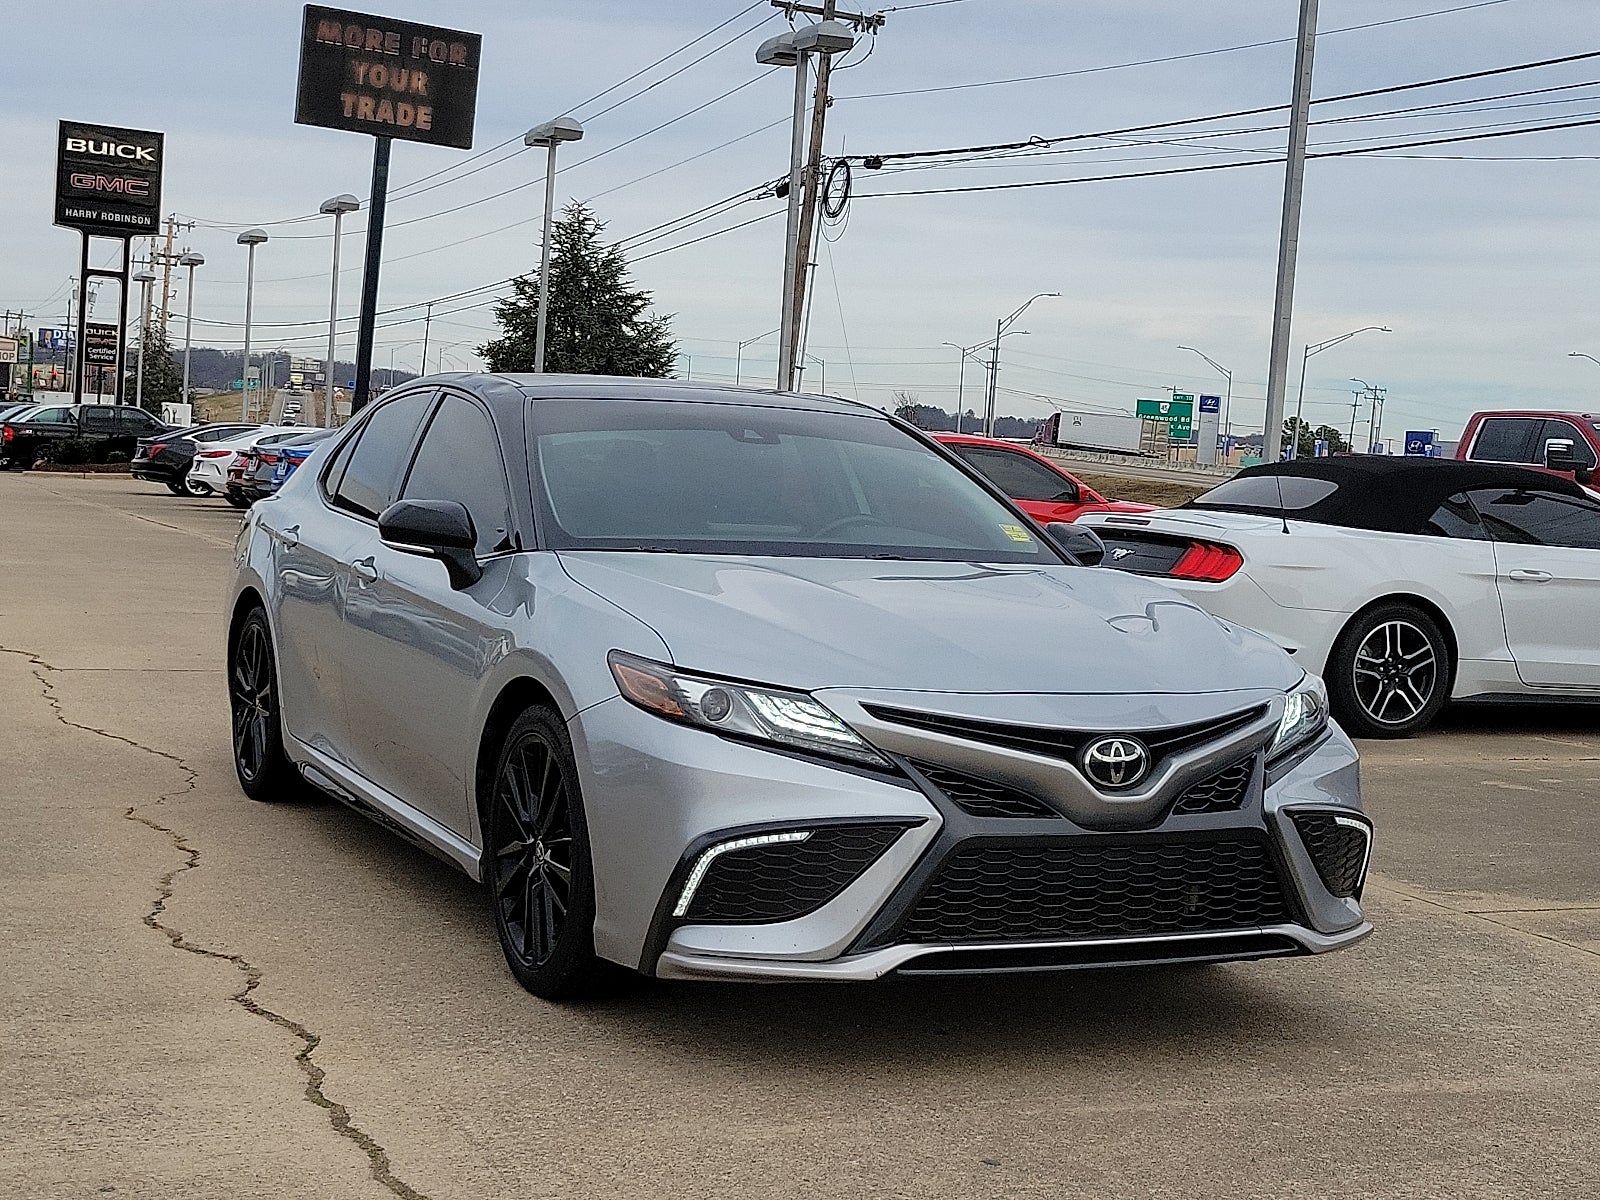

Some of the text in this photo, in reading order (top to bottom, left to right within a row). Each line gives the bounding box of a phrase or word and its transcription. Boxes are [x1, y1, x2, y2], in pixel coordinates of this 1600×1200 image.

[316, 20, 400, 55] MORE
[352, 61, 428, 95] YOUR
[341, 91, 433, 130] TRADE
[66, 138, 156, 161] BUICK
[70, 173, 149, 195] GMC
[65, 208, 151, 225] HARRY ROBINSON
[88, 347, 116, 355] Certified
